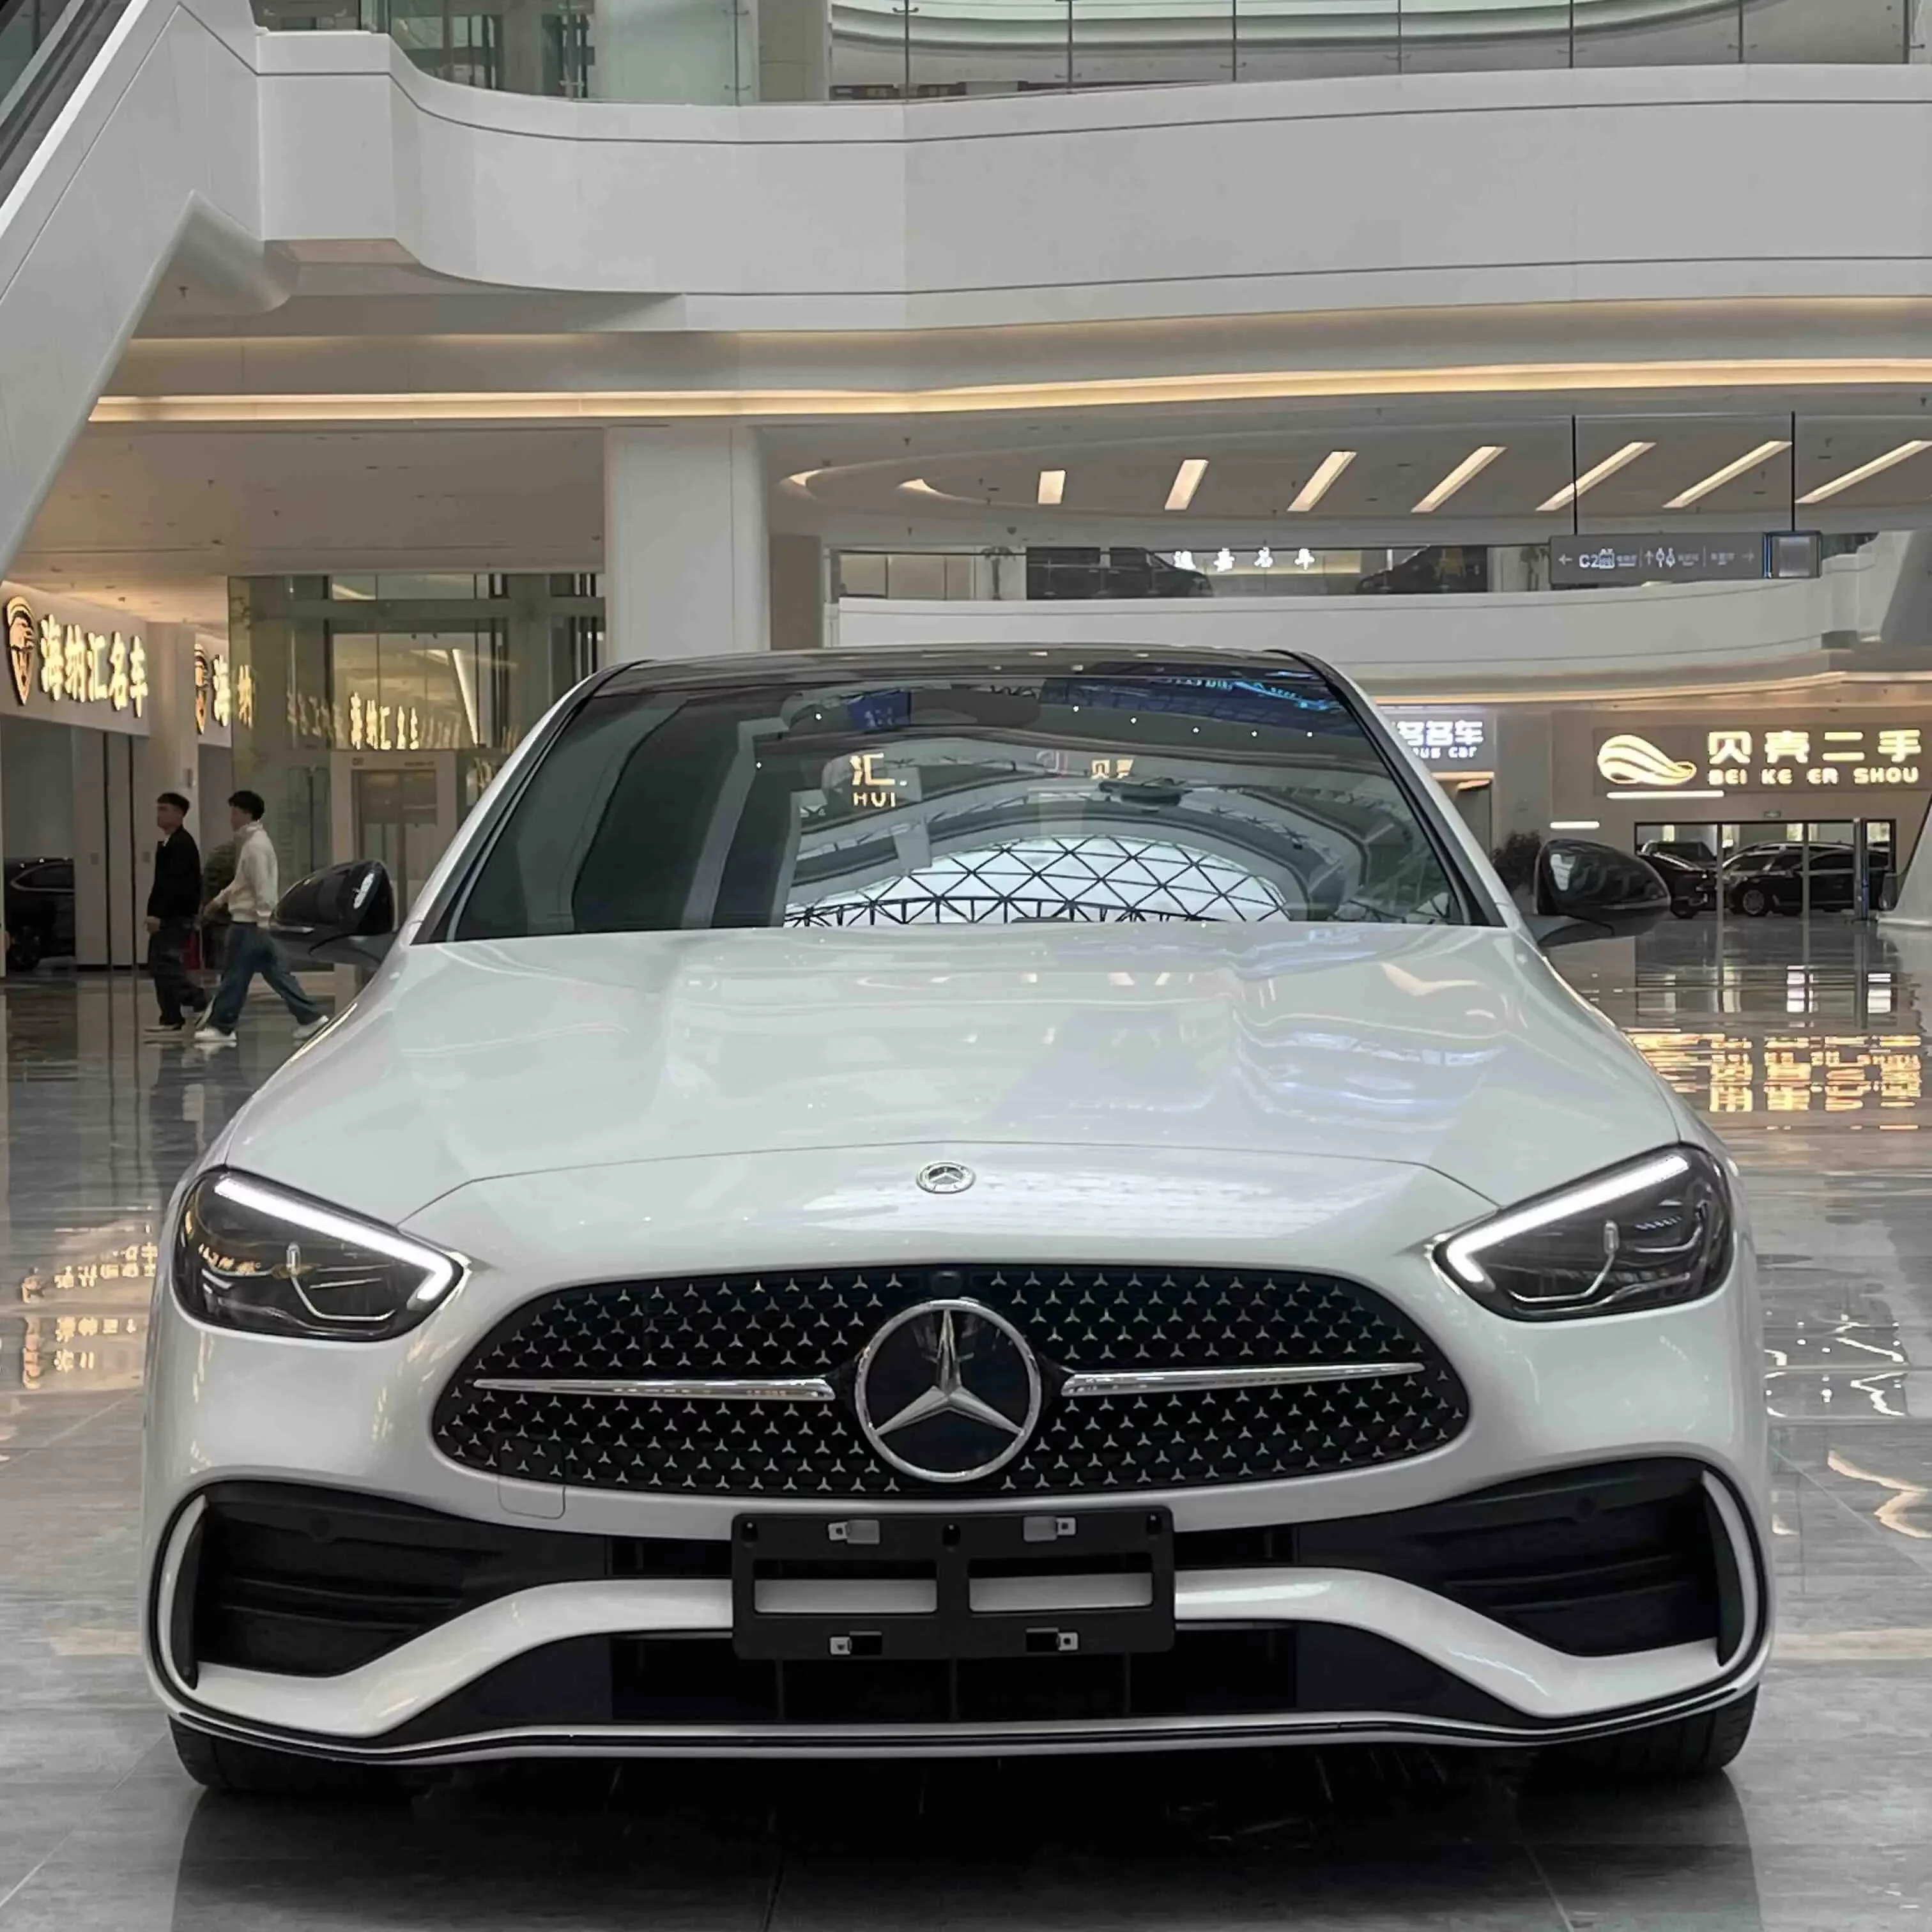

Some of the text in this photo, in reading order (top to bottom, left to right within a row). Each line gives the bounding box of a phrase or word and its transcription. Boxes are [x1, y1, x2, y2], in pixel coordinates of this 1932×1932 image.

[1761, 769, 1793, 785] KE
[1807, 768, 1839, 785] ER
[1854, 767, 1919, 784] SHOU
